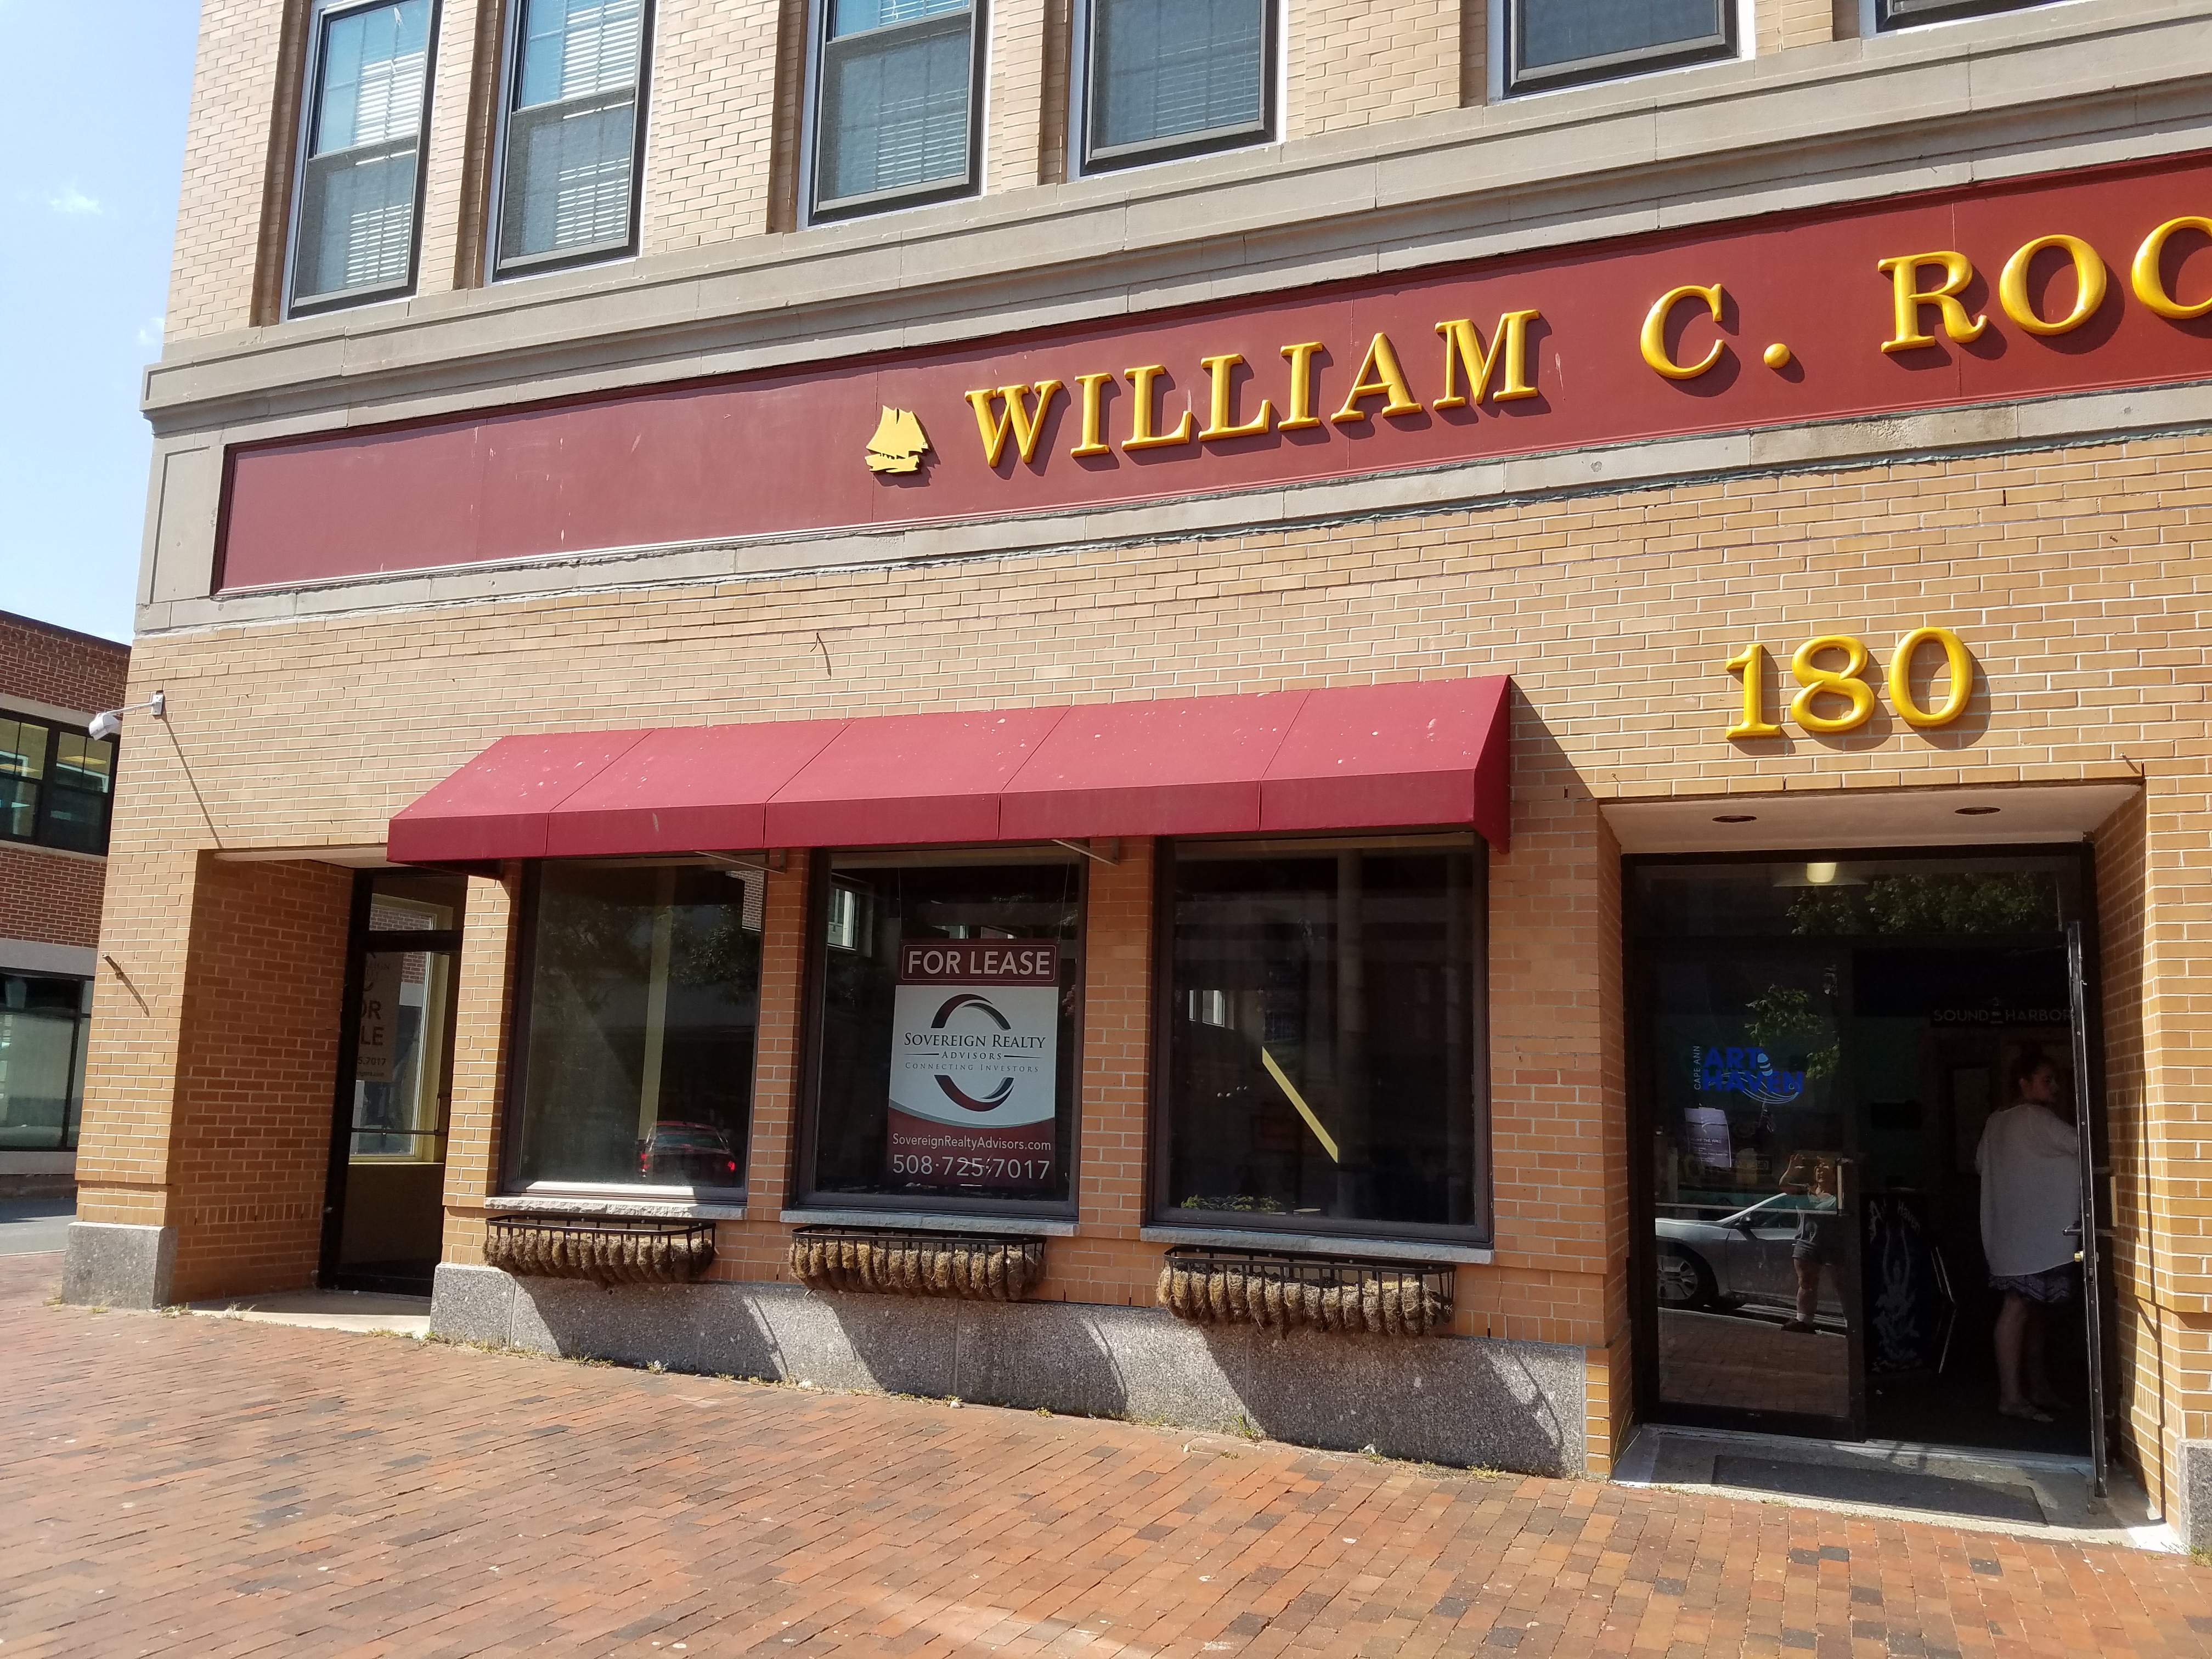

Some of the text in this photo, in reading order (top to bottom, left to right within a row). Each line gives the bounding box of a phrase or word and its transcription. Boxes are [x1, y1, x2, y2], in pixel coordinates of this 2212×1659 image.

[964, 308, 1540, 467] WILLIAM
[1640, 283, 1790, 379] C.
[1725, 626, 1973, 741] 180
[908, 950, 1050, 975] FOR LEASE
[1933, 1009, 1988, 1022] SOUND
[904, 1032, 1046, 1049] SOVEREIGN REALTY
[941, 1051, 1002, 1060] ADVISORS
[1703, 1047, 1765, 1069] ART
[905, 1062, 1039, 1073] CONNECTING INVESTORS
[1702, 1069, 1804, 1093] HAVEN
[893, 1133, 1051, 1151] SovereignRealtyAdvisors.com
